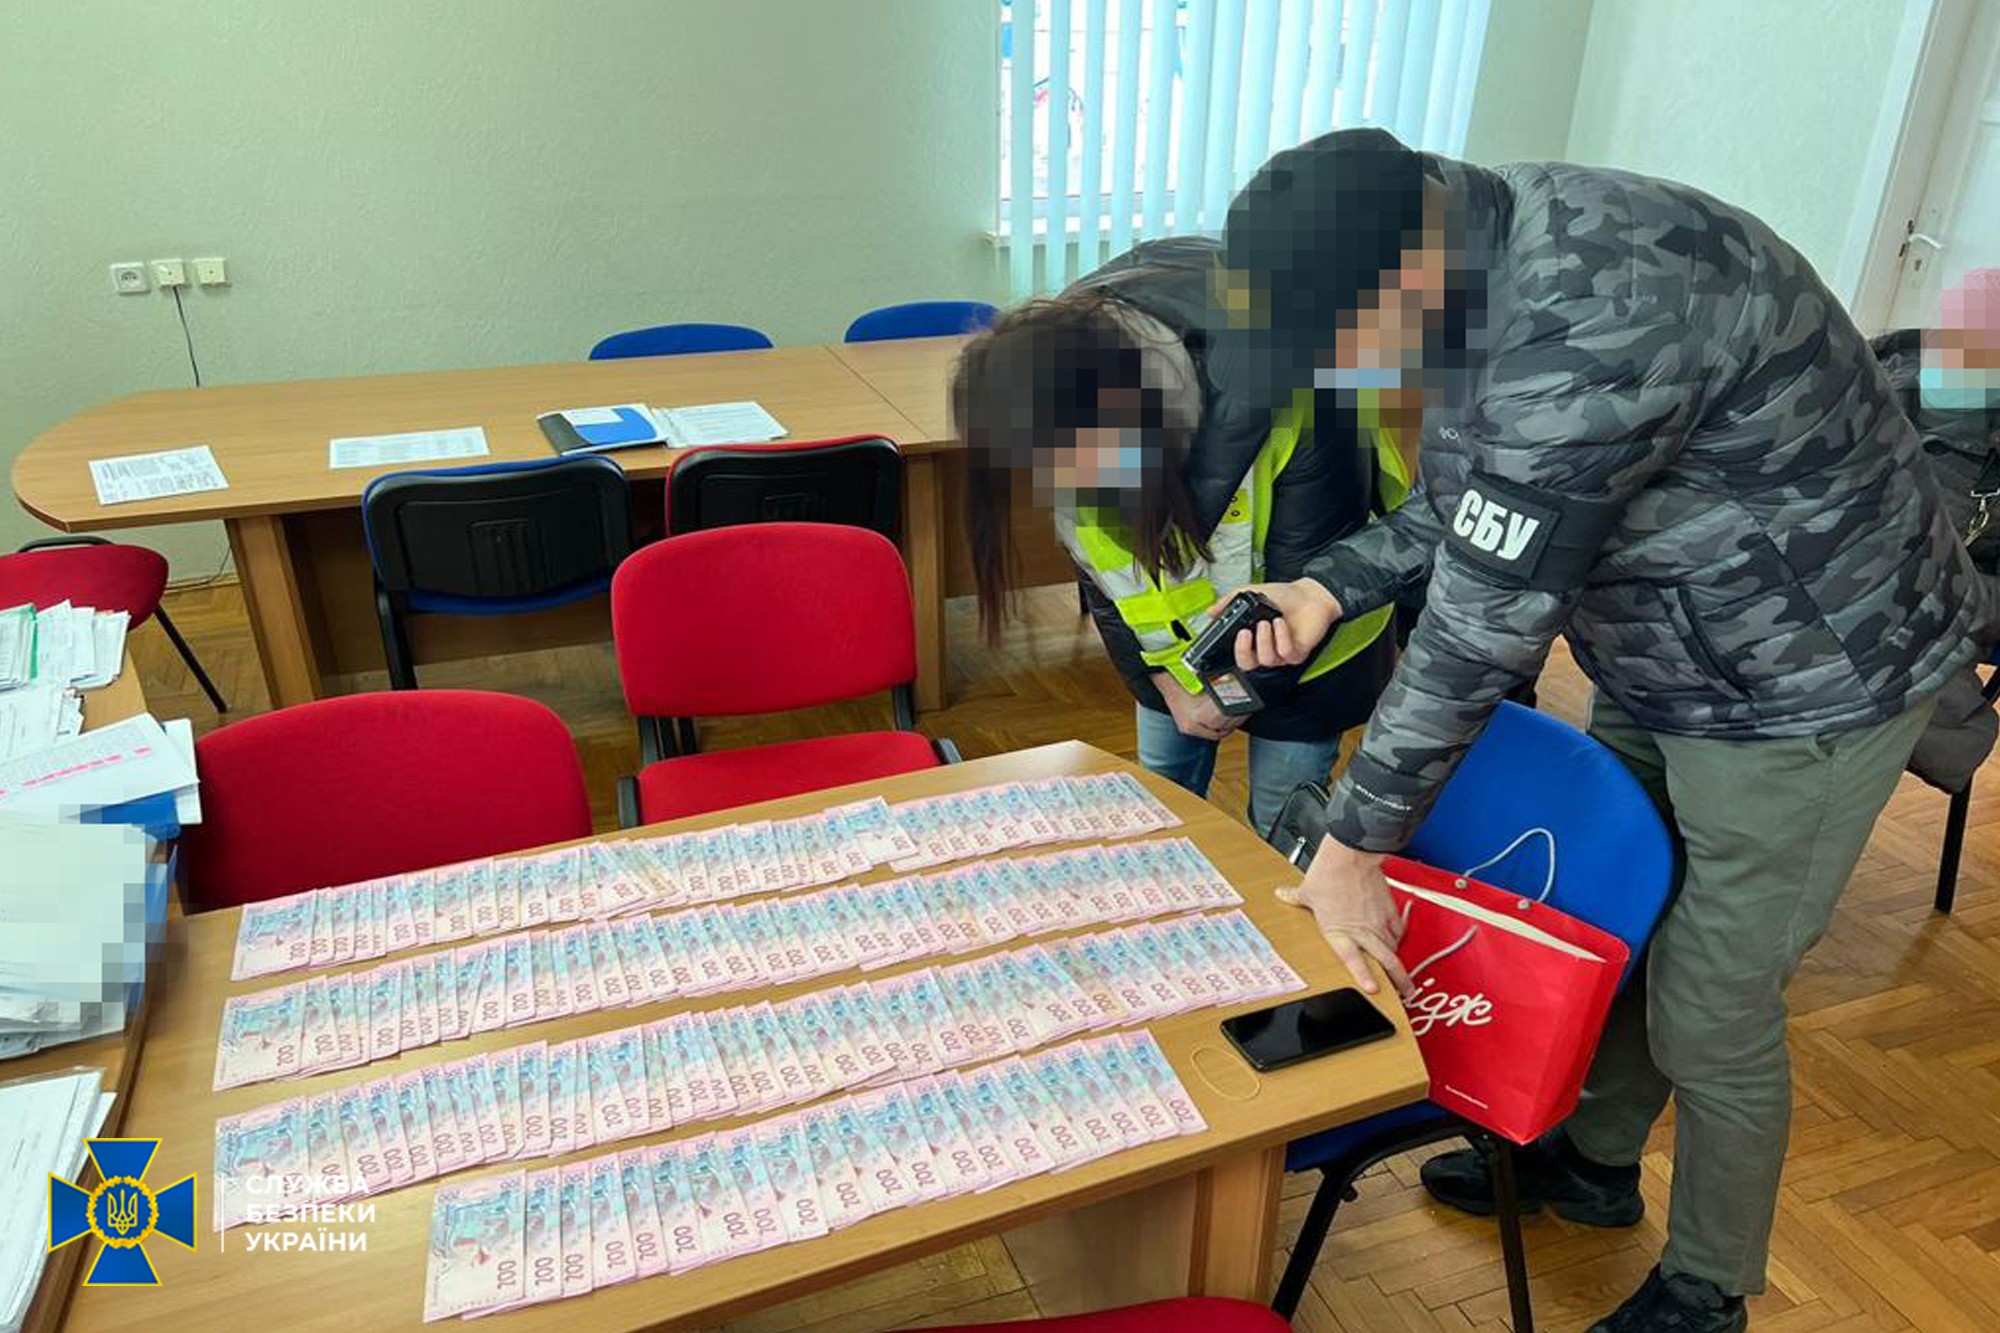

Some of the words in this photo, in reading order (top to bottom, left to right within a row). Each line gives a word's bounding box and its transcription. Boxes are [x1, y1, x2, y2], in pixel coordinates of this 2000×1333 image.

[1453, 489, 1540, 561] СБУ
[876, 1169, 904, 1193] 200
[912, 1161, 935, 1187] 200
[836, 1182, 860, 1208] 200
[724, 1212, 749, 1239] 200
[754, 1208, 777, 1234] 200
[796, 1199, 818, 1225] 200
[636, 1233, 657, 1260] 200
[674, 1225, 697, 1253] 200
[566, 1254, 583, 1282] 200
[605, 1241, 626, 1268] 200
[497, 1261, 516, 1289] 200
[535, 1257, 554, 1285] 200
